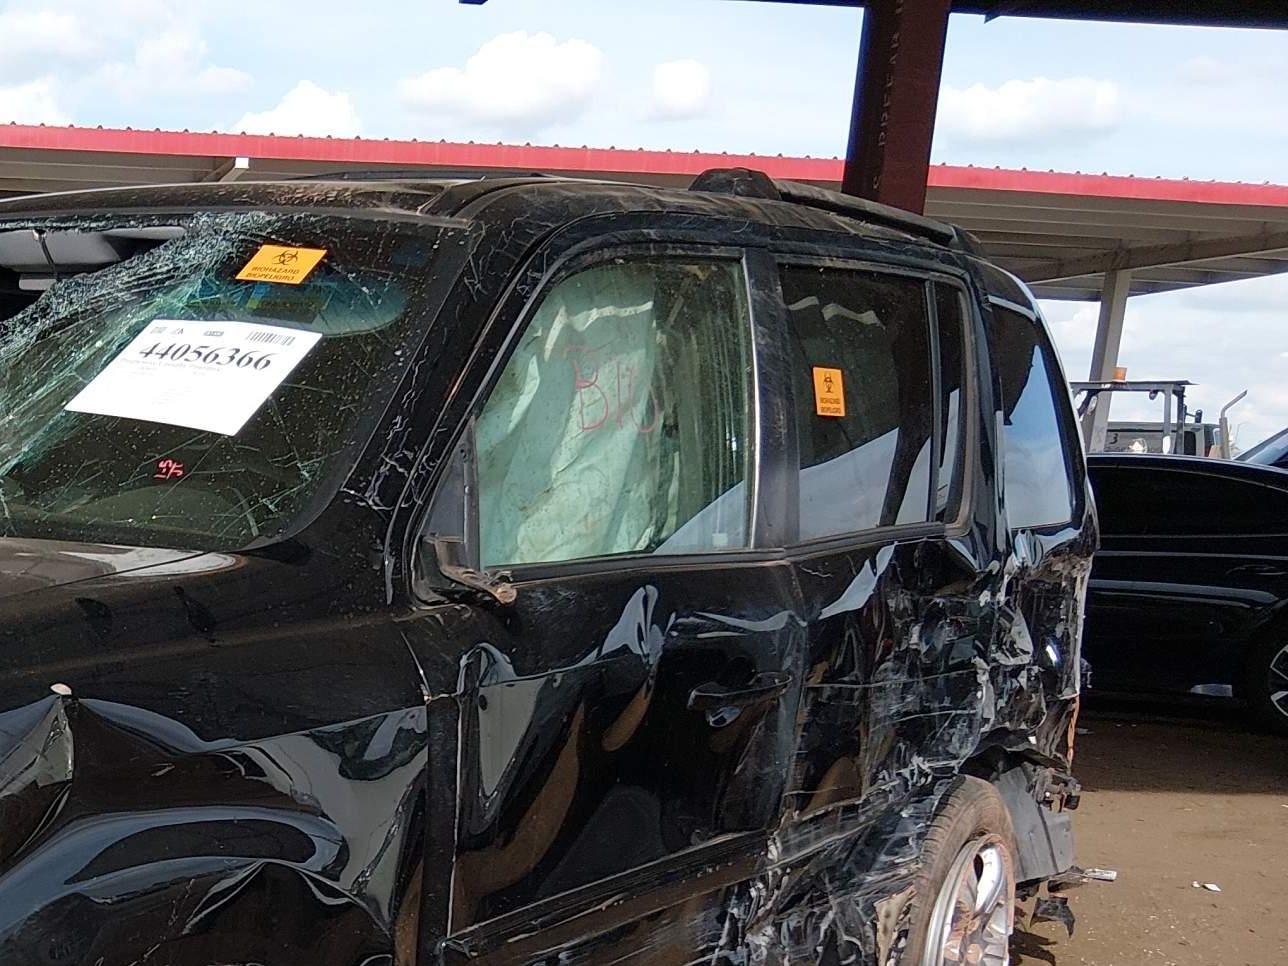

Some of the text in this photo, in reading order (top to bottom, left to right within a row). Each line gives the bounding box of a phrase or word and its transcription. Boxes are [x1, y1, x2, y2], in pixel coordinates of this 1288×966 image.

[250, 265, 301, 275] BIOHAZARD
[245, 272, 296, 281] BIOPELIGRO
[139, 341, 278, 371] 44056366
